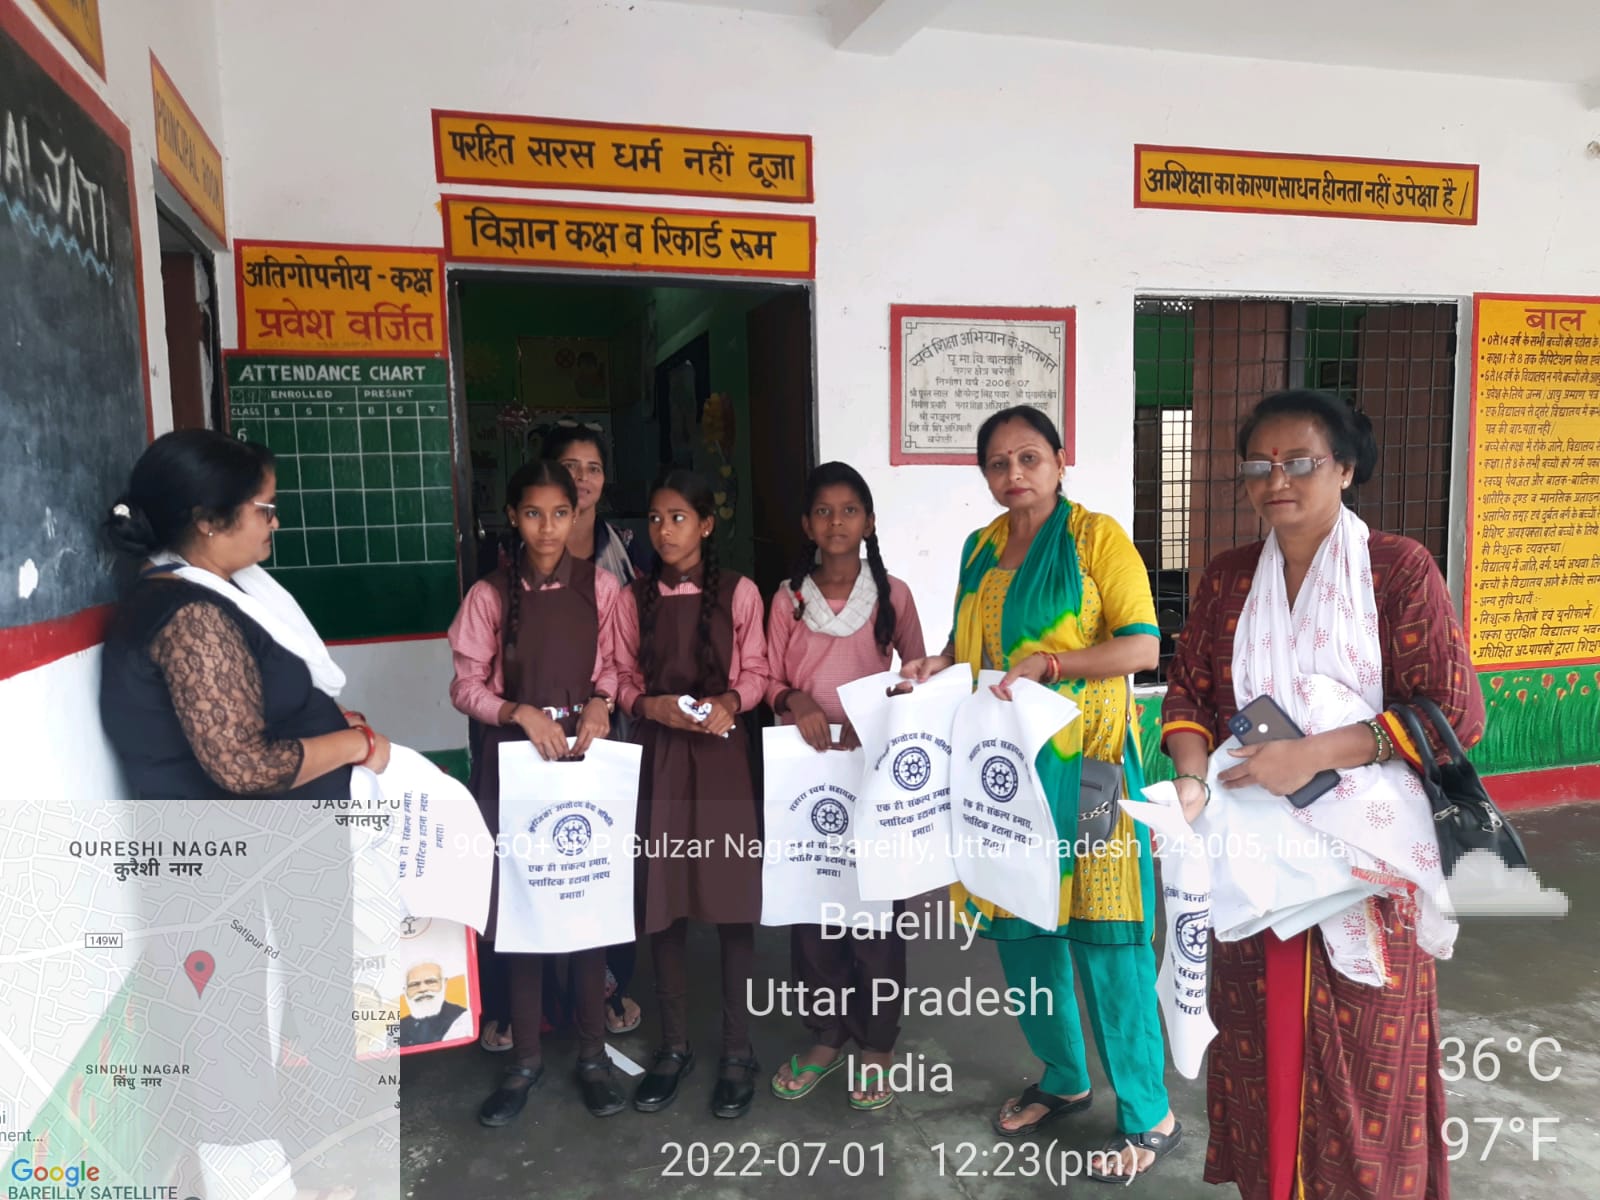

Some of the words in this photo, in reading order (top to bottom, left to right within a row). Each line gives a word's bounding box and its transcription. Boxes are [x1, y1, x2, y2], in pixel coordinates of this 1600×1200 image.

[448, 123, 515, 166] परहित
[527, 136, 595, 169] सरस
[612, 138, 663, 173] धर्म
[684, 141, 734, 182] नहीं
[748, 152, 795, 189] दूजा
[1144, 159, 1213, 199] अशिक्षा
[1365, 173, 1391, 208] नहीं
[1393, 175, 1439, 210] उपेक्षा
[464, 207, 558, 254] विज्ञान
[566, 221, 618, 257] कक्ष
[625, 223, 643, 253] व
[652, 217, 722, 259] रिकार्ड
[730, 228, 776, 262] रूम
[243, 255, 371, 291] अतिगोपनीय
[390, 267, 434, 296] कक्ष
[256, 298, 335, 340] प्रवेश
[346, 302, 434, 342] वर्जित
[1525, 308, 1586, 331] बाल
[960, 328, 1006, 347] अभियान
[239, 365, 361, 381] ATTENDANCE
[369, 365, 426, 380] CHART
[271, 390, 333, 399] ENROLLED
[364, 389, 414, 398] PRESENT
[231, 407, 260, 416] CLASS
[337, 406, 344, 414] T
[428, 405, 436, 413] T
[528, 864, 544, 872] एक
